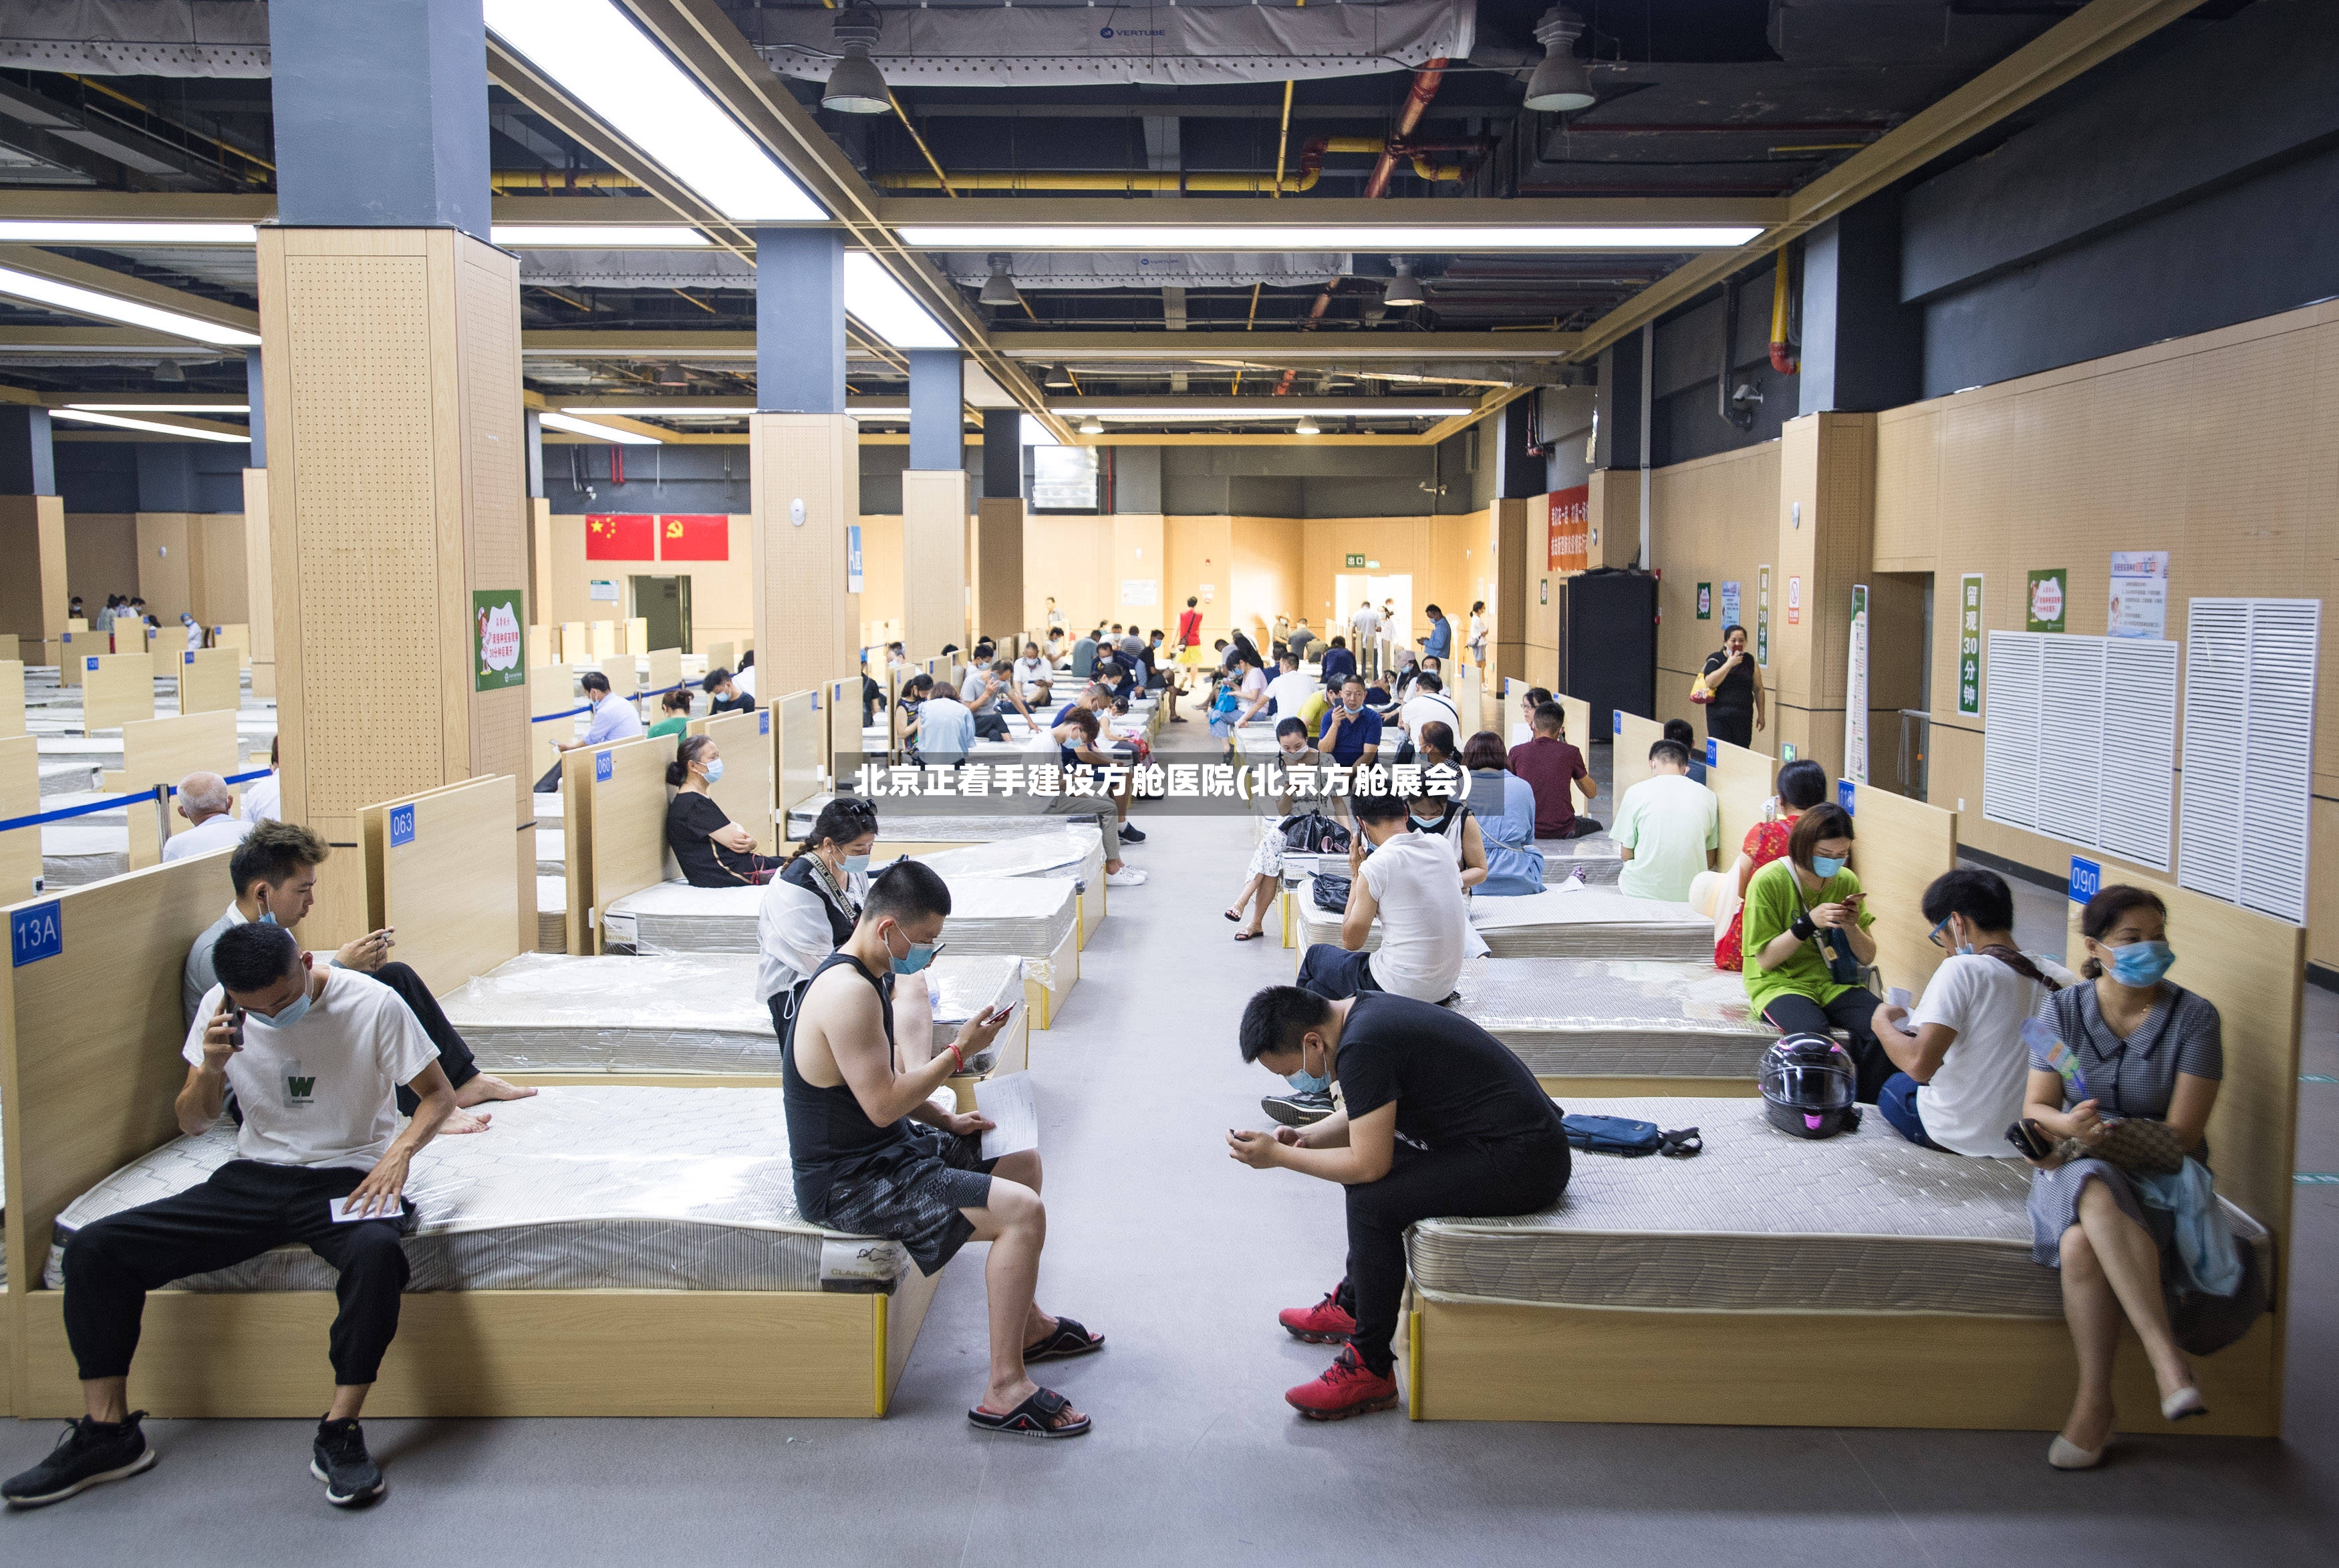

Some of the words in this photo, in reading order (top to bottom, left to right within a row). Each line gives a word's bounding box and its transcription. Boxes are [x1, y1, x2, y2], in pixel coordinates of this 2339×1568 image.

[1348, 557, 1363, 565] 出口
[1963, 586, 1977, 706] 留观30分钟
[598, 757, 610, 774] 060
[394, 812, 412, 836] 063
[2072, 867, 2096, 895] 090
[18, 915, 57, 949] 13A
[288, 1076, 316, 1096] W
